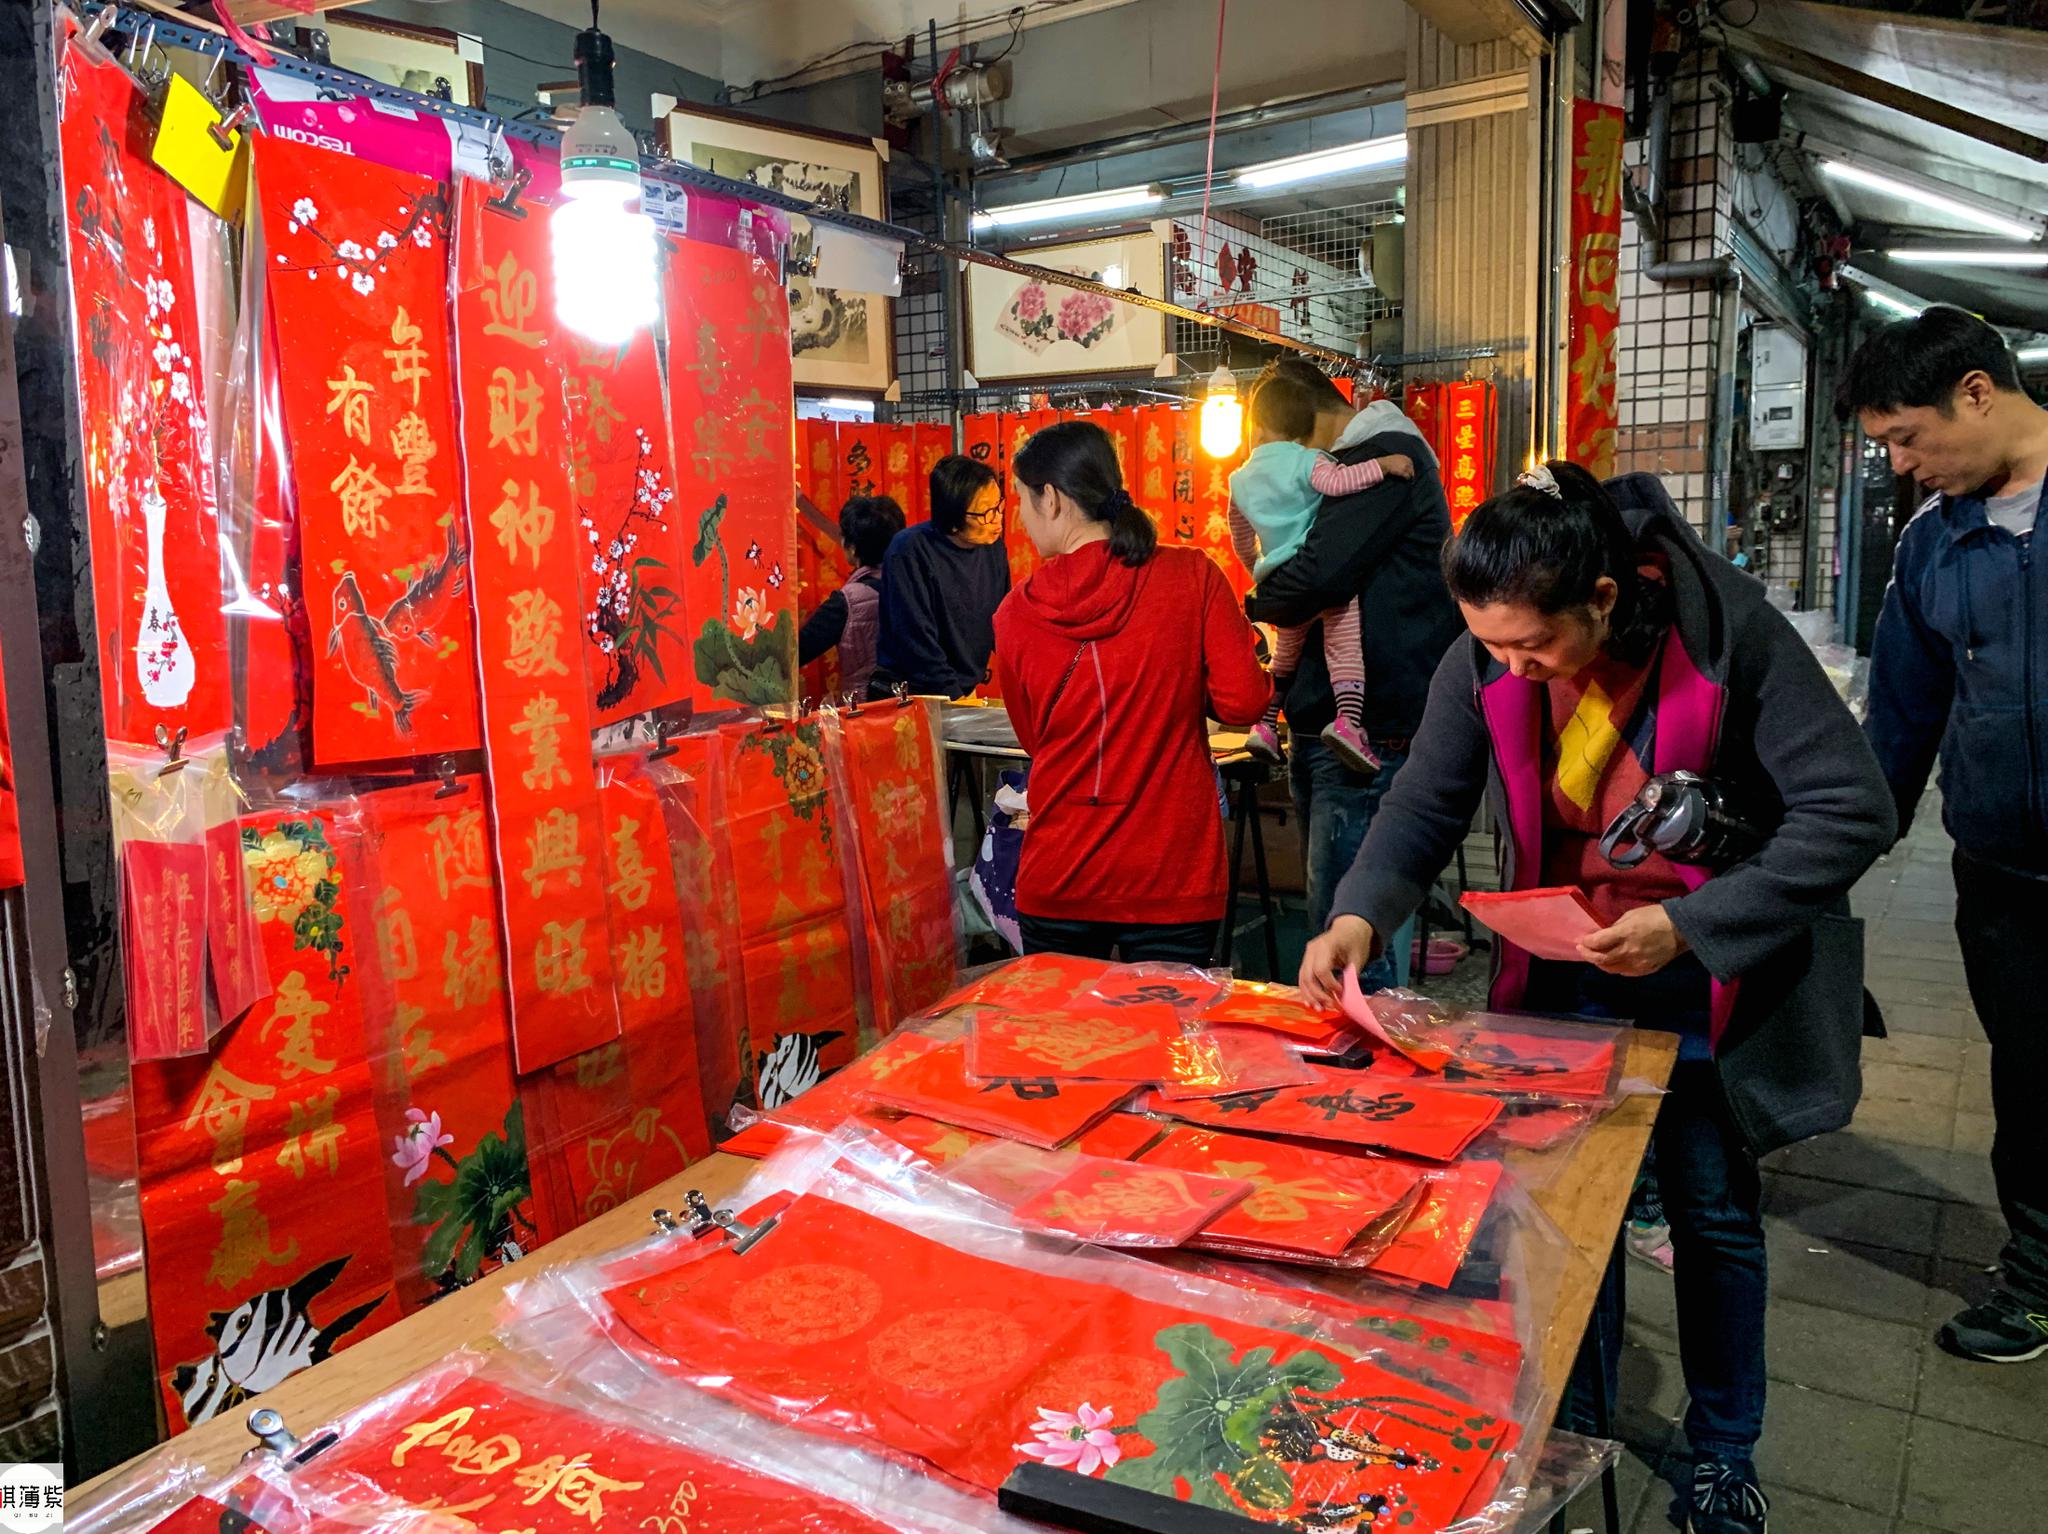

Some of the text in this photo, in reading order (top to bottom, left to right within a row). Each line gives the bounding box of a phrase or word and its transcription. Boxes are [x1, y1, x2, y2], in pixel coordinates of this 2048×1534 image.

[272, 123, 356, 157] TESCOM
[325, 363, 393, 539] 有餘
[384, 304, 438, 497] 年豐
[686, 317, 736, 483] 喜樂
[736, 286, 782, 463] 平安
[147, 606, 162, 632] 春
[480, 249, 593, 996] 迎財神駿業興旺
